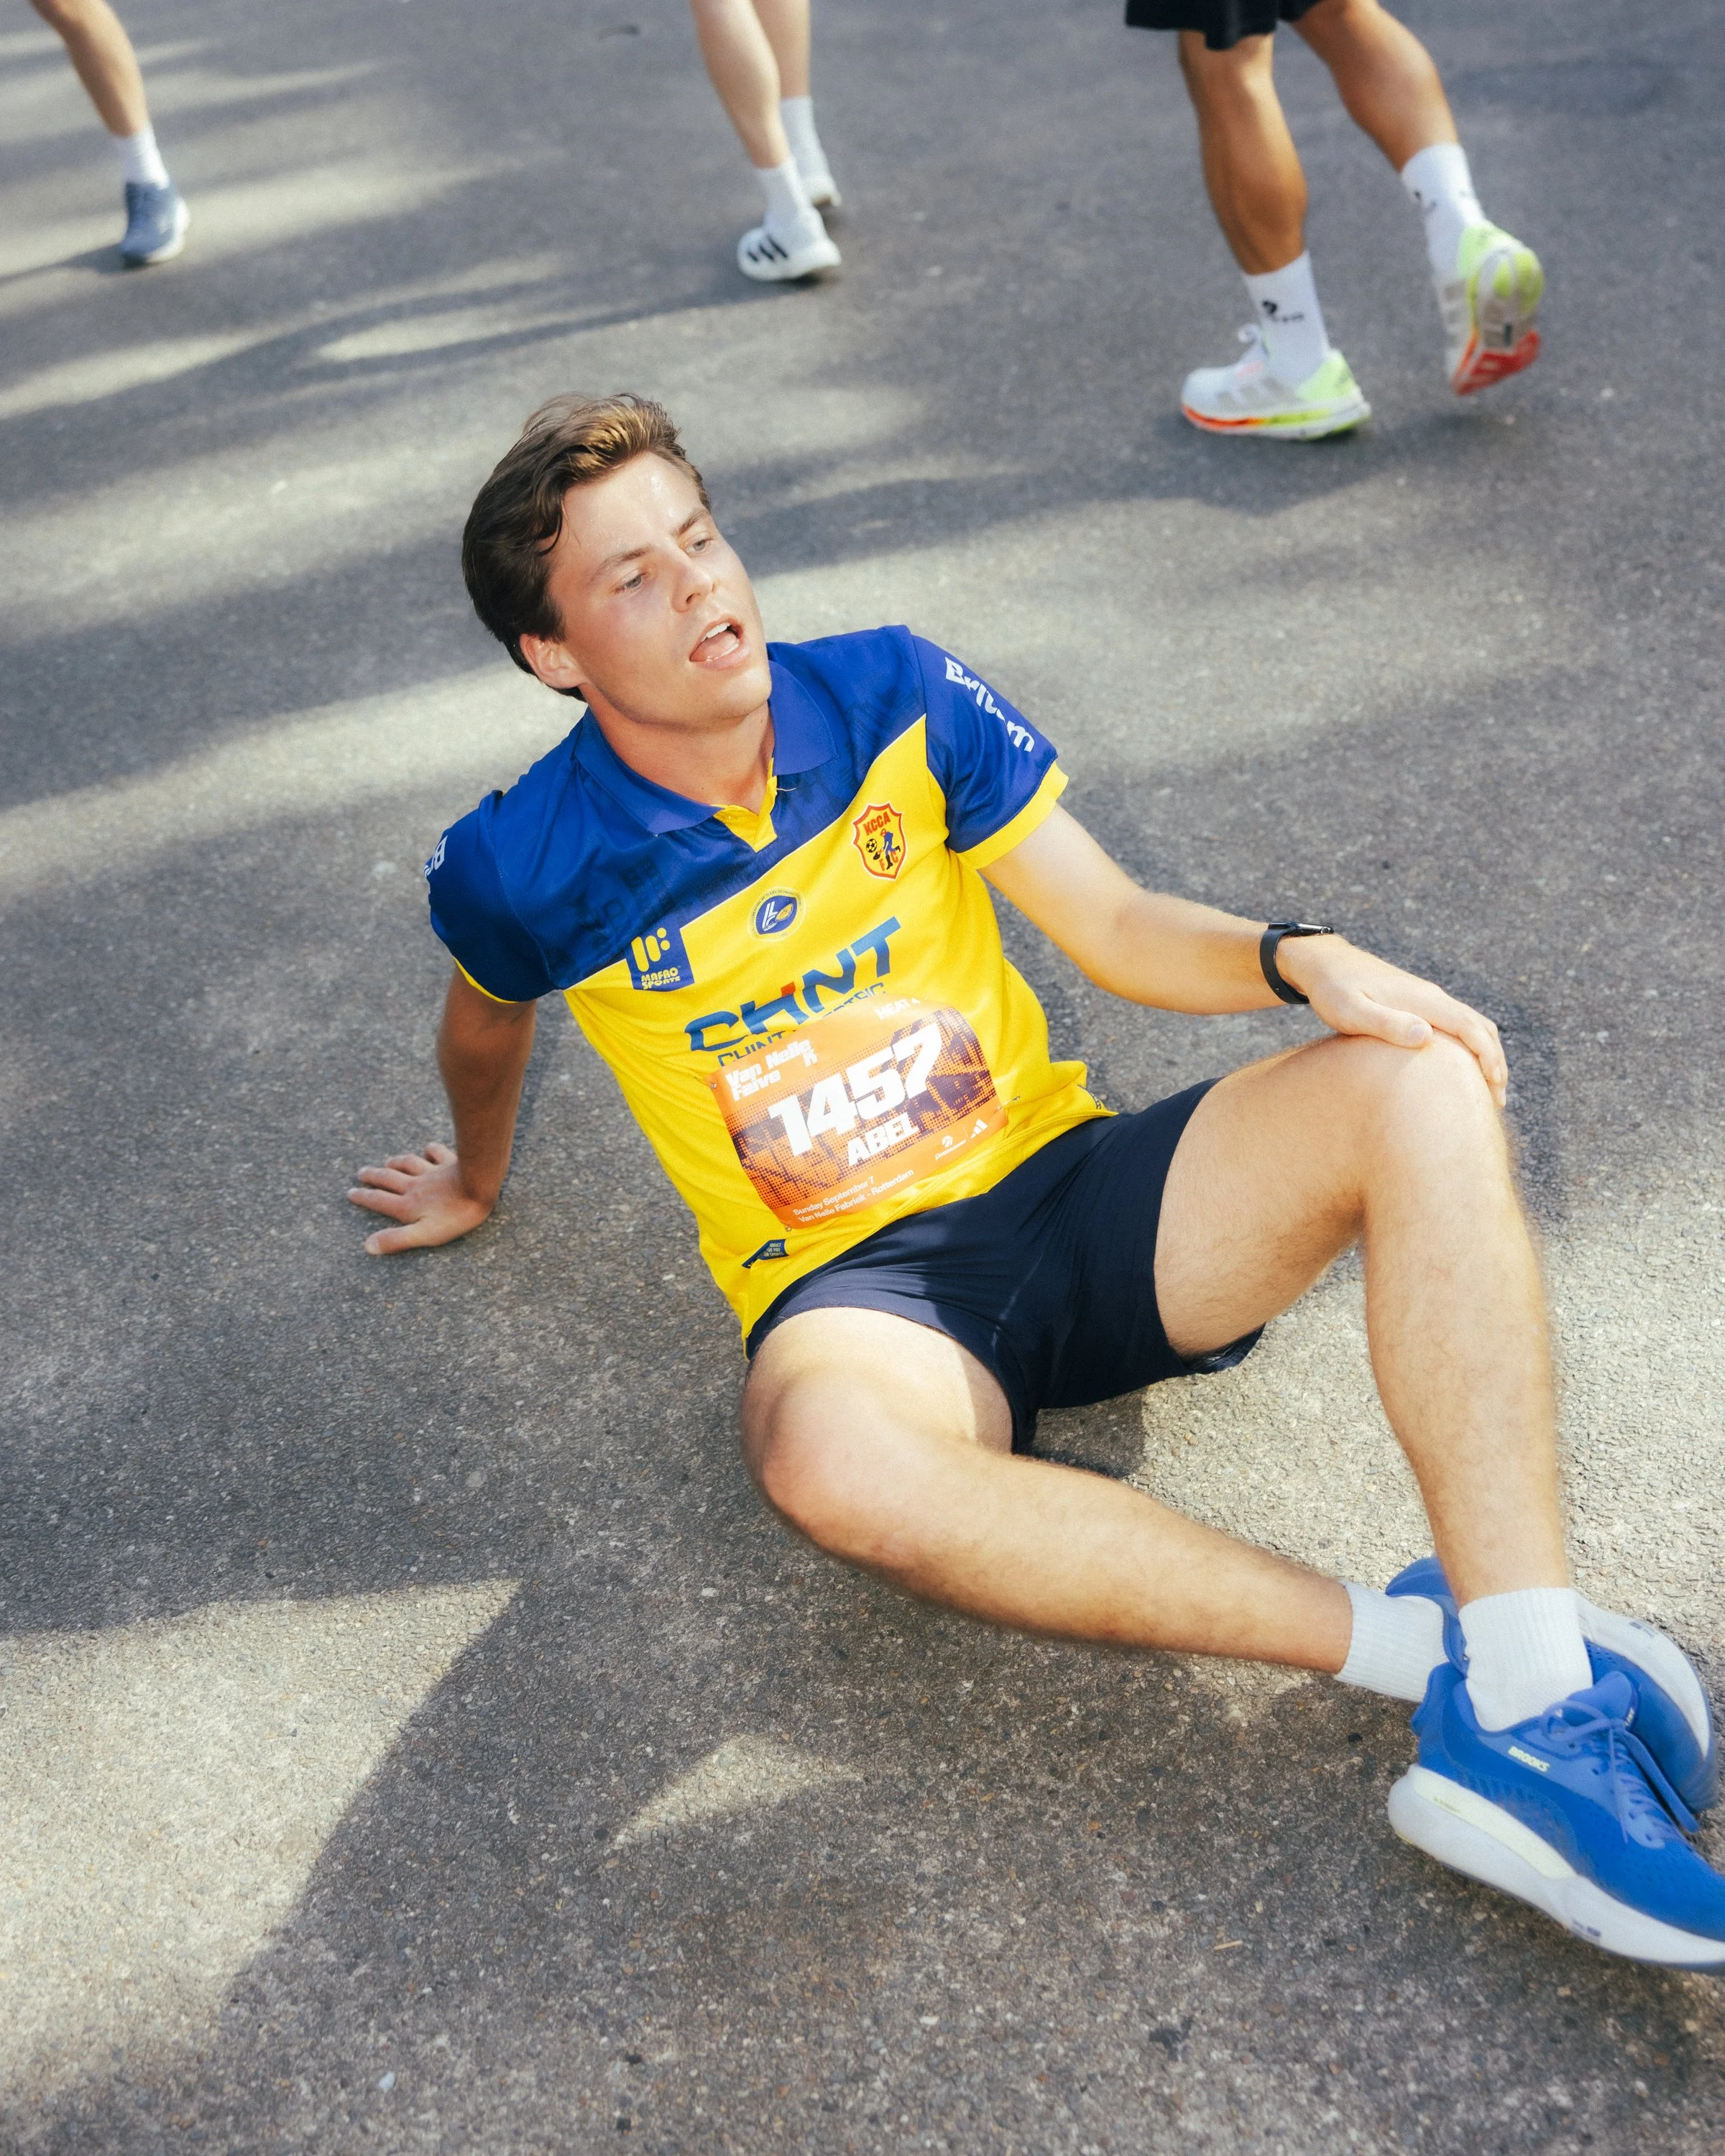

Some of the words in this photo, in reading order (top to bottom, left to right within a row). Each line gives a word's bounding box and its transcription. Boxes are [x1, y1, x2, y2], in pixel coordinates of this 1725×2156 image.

[862, 811, 891, 836] KCCA
[641, 967, 678, 982] MAFRO
[641, 976, 681, 990] SPORTS
[684, 916, 901, 1052] CHINT
[874, 998, 911, 1021] HEAT
[725, 1063, 763, 1087] Van
[765, 1039, 812, 1069] Nelle
[767, 1022, 942, 1157] 1457
[847, 1112, 919, 1167] ABEL
[793, 1202, 824, 1216] Sunday
[823, 1180, 868, 1207] September
[868, 1175, 875, 1186] 7
[798, 1212, 815, 1223] Van
[815, 1208, 835, 1219] Nelle
[834, 1193, 867, 1212] Fabriek
[870, 1168, 915, 1196] Rotterdam
[1508, 1745, 1550, 1773] BROOKS
